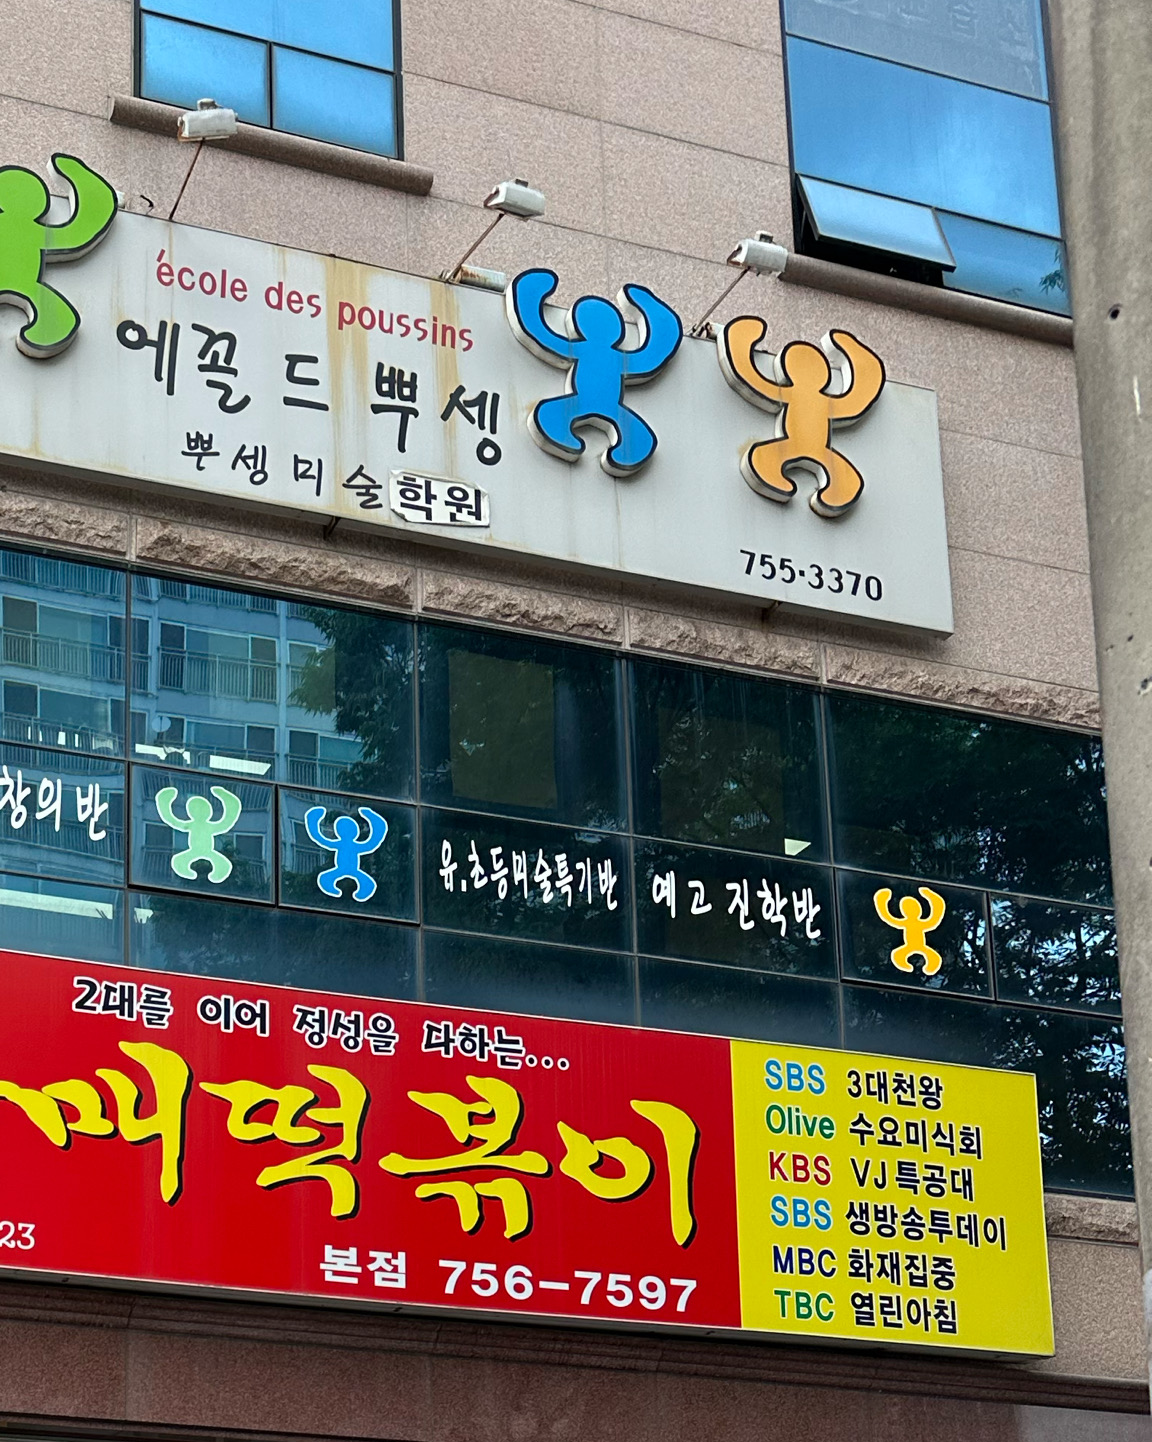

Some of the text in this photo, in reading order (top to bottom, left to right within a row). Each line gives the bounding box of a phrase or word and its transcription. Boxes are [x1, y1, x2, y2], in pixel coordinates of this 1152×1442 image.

[156, 248, 474, 352] école des poussins
[116, 319, 251, 414] 에꼴
[282, 354, 330, 412] 드
[71, 976, 174, 1030] 2대를
[196, 994, 271, 1037] 이어
[292, 1004, 400, 1056] 정성을
[764, 1058, 943, 1110] SBS 3대천왕
[765, 1105, 983, 1160] Olive 수요미식회
[768, 1151, 832, 1186] KBS
[770, 1195, 1007, 1251] SBS 생방송투데이
[318, 1243, 698, 1314] 본점 756-7597
[772, 1245, 957, 1291] MBC 화재집중
[773, 1288, 958, 1335] TBC 열린아침
